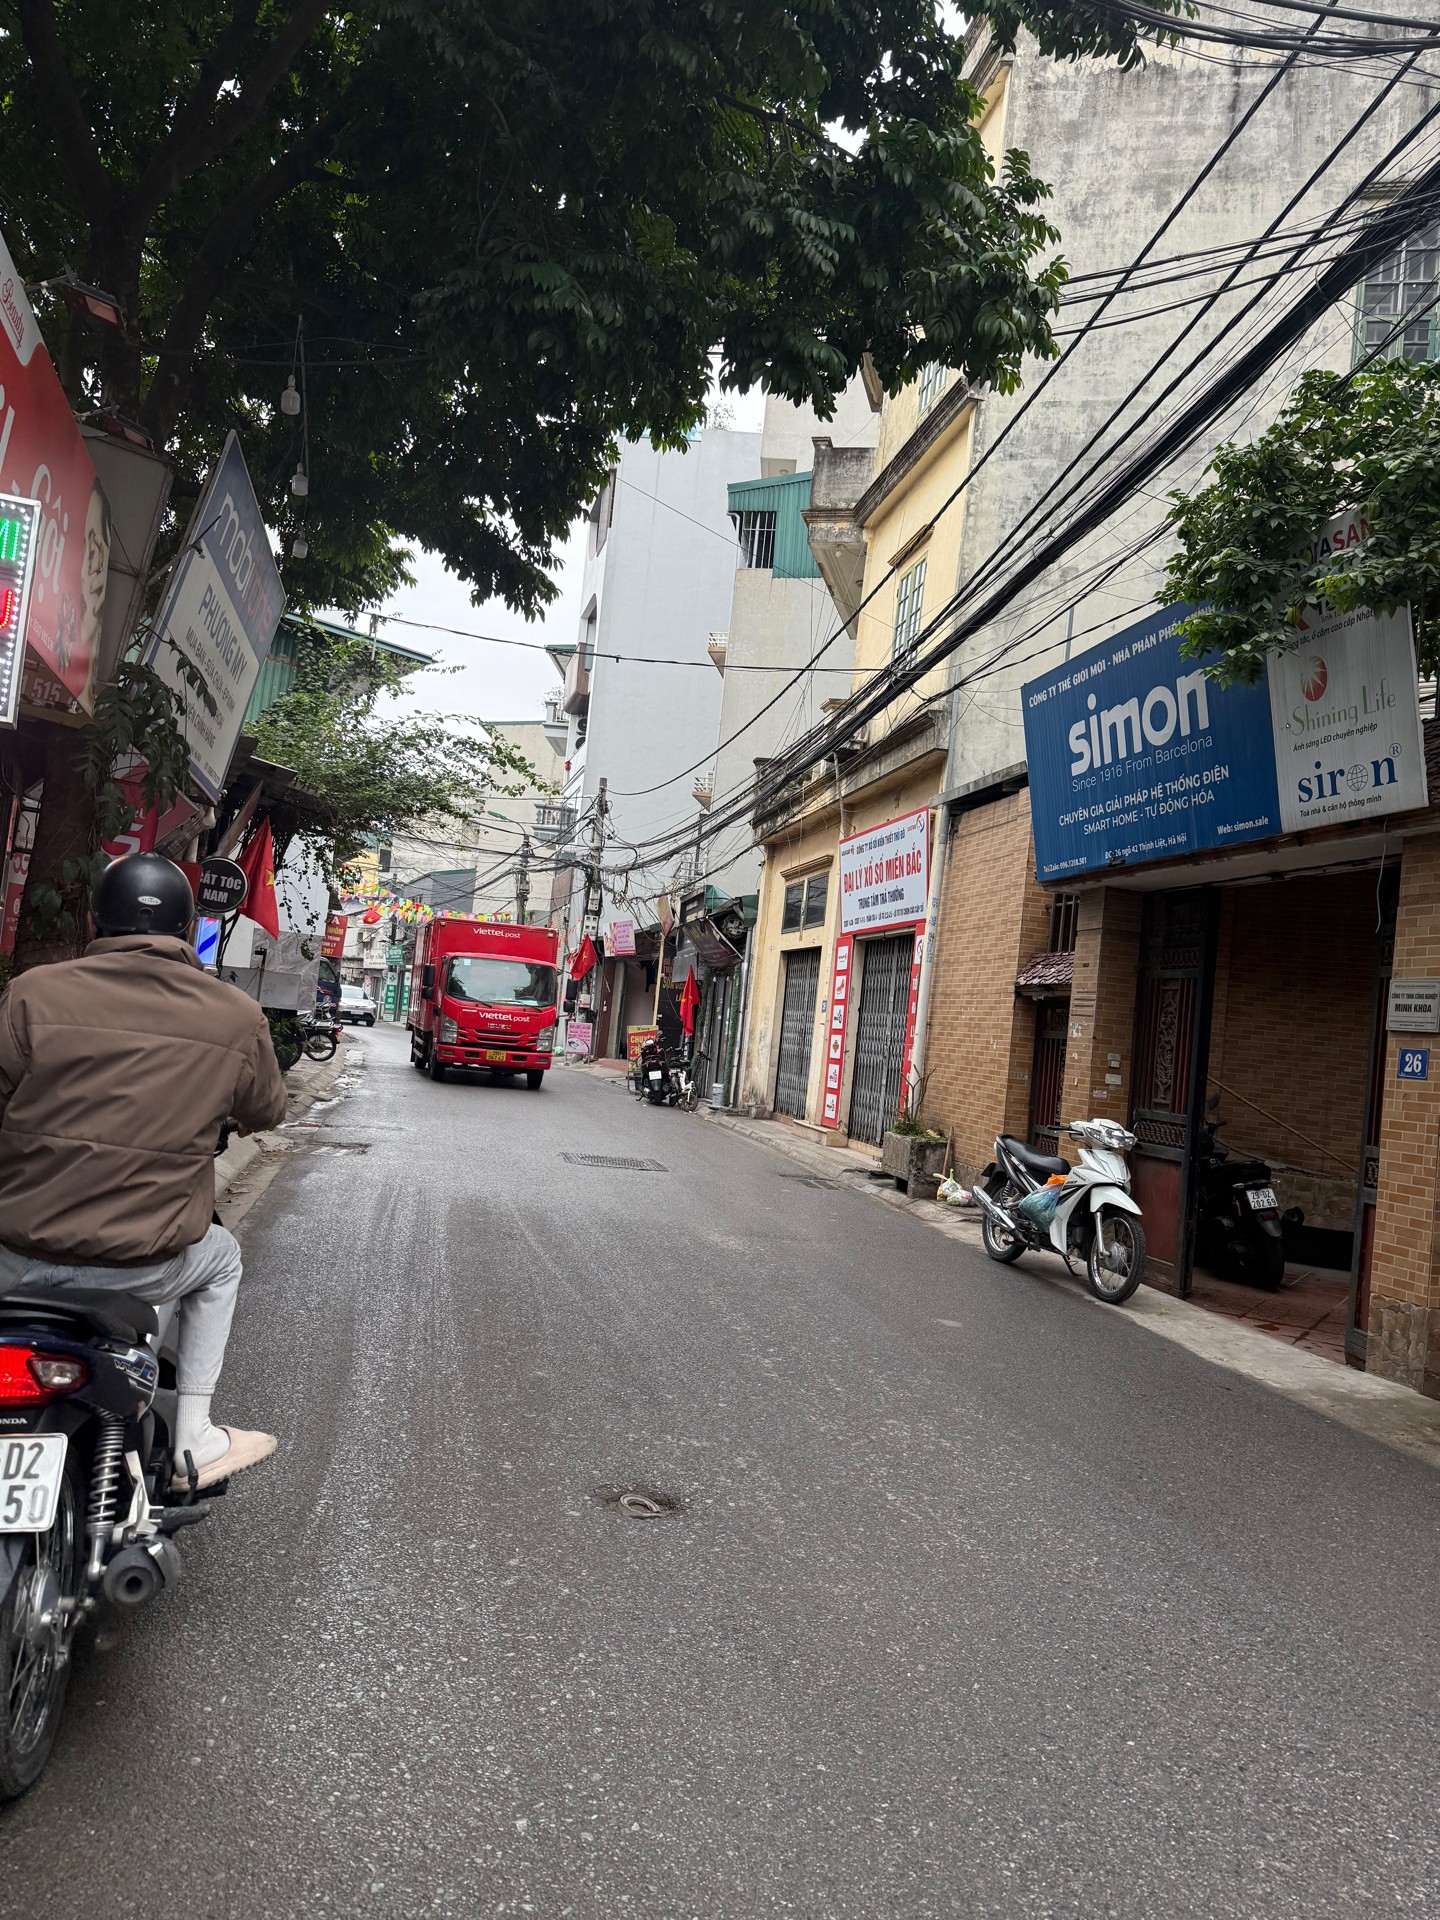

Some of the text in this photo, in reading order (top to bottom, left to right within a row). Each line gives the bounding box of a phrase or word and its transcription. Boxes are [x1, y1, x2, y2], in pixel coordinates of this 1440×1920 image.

[1331, 624, 1342, 633] cao
[1029, 690, 1047, 708] CÔNG
[1048, 686, 1057, 699] TY
[1058, 675, 1072, 695] THẾ
[1072, 669, 1088, 686] GIỚI
[1090, 658, 1106, 678] MỚI
[1112, 647, 1130, 666] NHÀ
[1132, 632, 1156, 657] PHÂN
[1292, 678, 1396, 736] Shining Life
[1069, 668, 1210, 777] simon
[1305, 736, 1319, 749] sáng
[1320, 735, 1332, 744] LED
[1332, 728, 1354, 742] chuyên
[1356, 723, 1378, 737] nghiệp
[1072, 736, 1213, 793] Since 1916 From Barcelona
[1059, 764, 1229, 827] CHUYÊN GIA GIẢI PHÁP HỆ THỐNG ĐIỆN
[1311, 804, 1321, 815] nhà
[1339, 800, 1347, 811] hộ
[1348, 798, 1365, 809] thông
[1366, 794, 1382, 806] minh
[1083, 818, 1110, 836] SMART
[1112, 813, 1138, 830] HOME
[1145, 804, 1158, 823] TỰ
[1159, 796, 1188, 816] ĐỘNG
[1191, 790, 1214, 806] HÓA
[1217, 816, 1268, 835] Web: simon.sale
[1132, 844, 1138, 853] 42
[1139, 841, 1154, 852] Thịnh
[1155, 838, 1167, 850] Liệt,
[1168, 835, 1176, 845] Hà
[1177, 832, 1187, 844] Nội
[844, 842, 922, 896] ĐẠI LÝ XỔ SỐ MIỀN BẮC
[220, 876, 242, 891] TÓC
[203, 888, 228, 903] NAM
[473, 928, 504, 936] viettel
[479, 1011, 513, 1021] viettel
[1395, 1003, 1432, 1013] MINH KHOA
[1404, 1053, 1422, 1073] 26
[3, 1484, 50, 1524] 50
